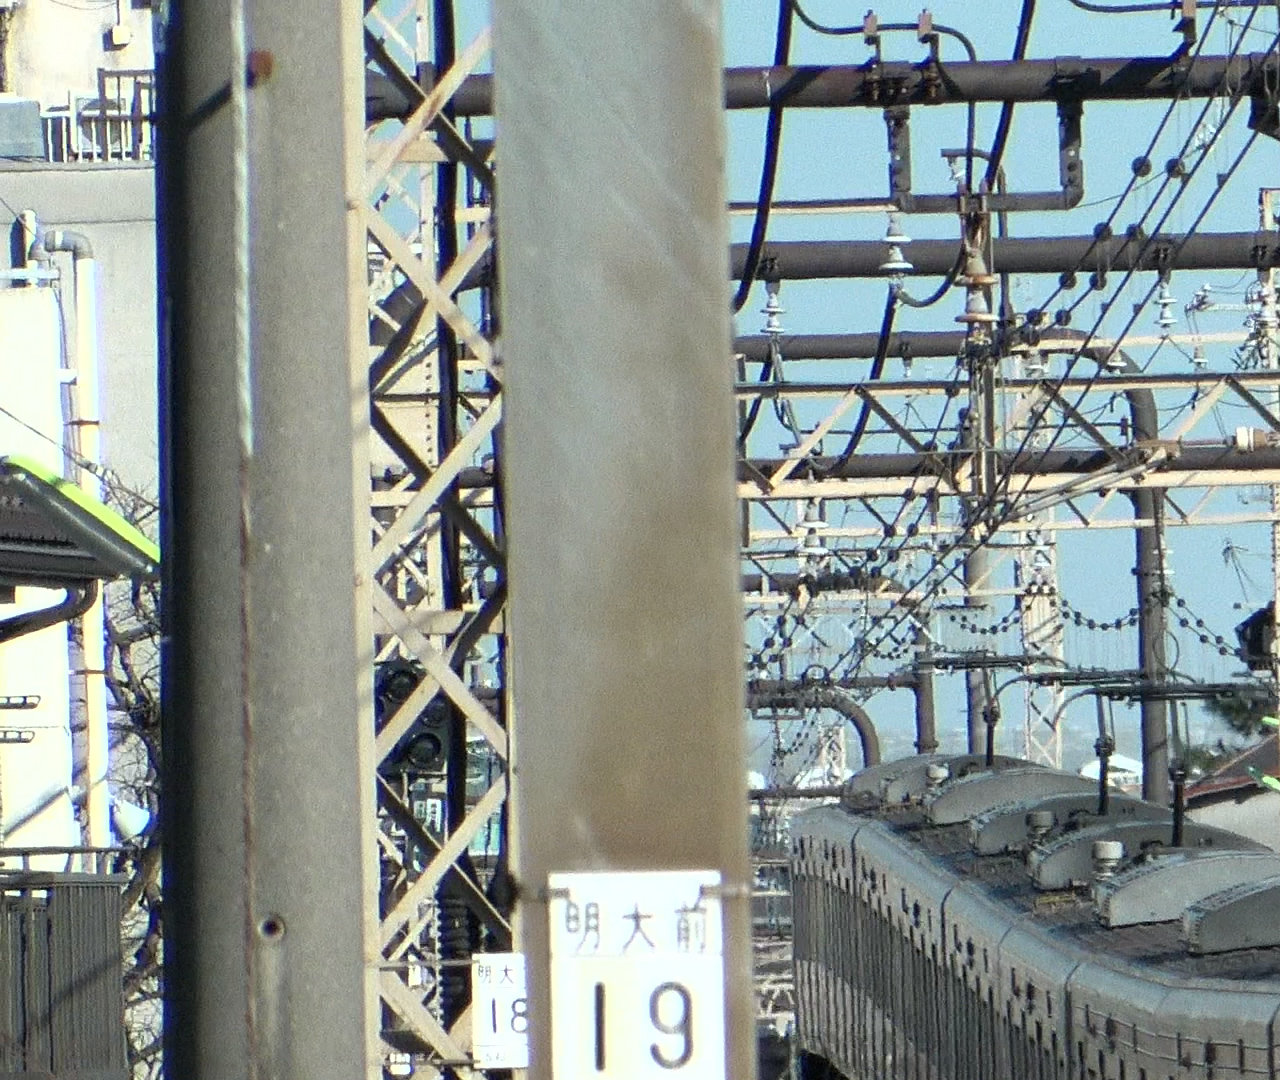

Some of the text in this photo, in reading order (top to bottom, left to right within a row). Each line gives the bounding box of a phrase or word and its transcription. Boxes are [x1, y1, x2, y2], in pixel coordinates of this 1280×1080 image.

[565, 901, 706, 954] 明大前
[492, 997, 528, 1034] 18
[594, 981, 693, 1071] 19
